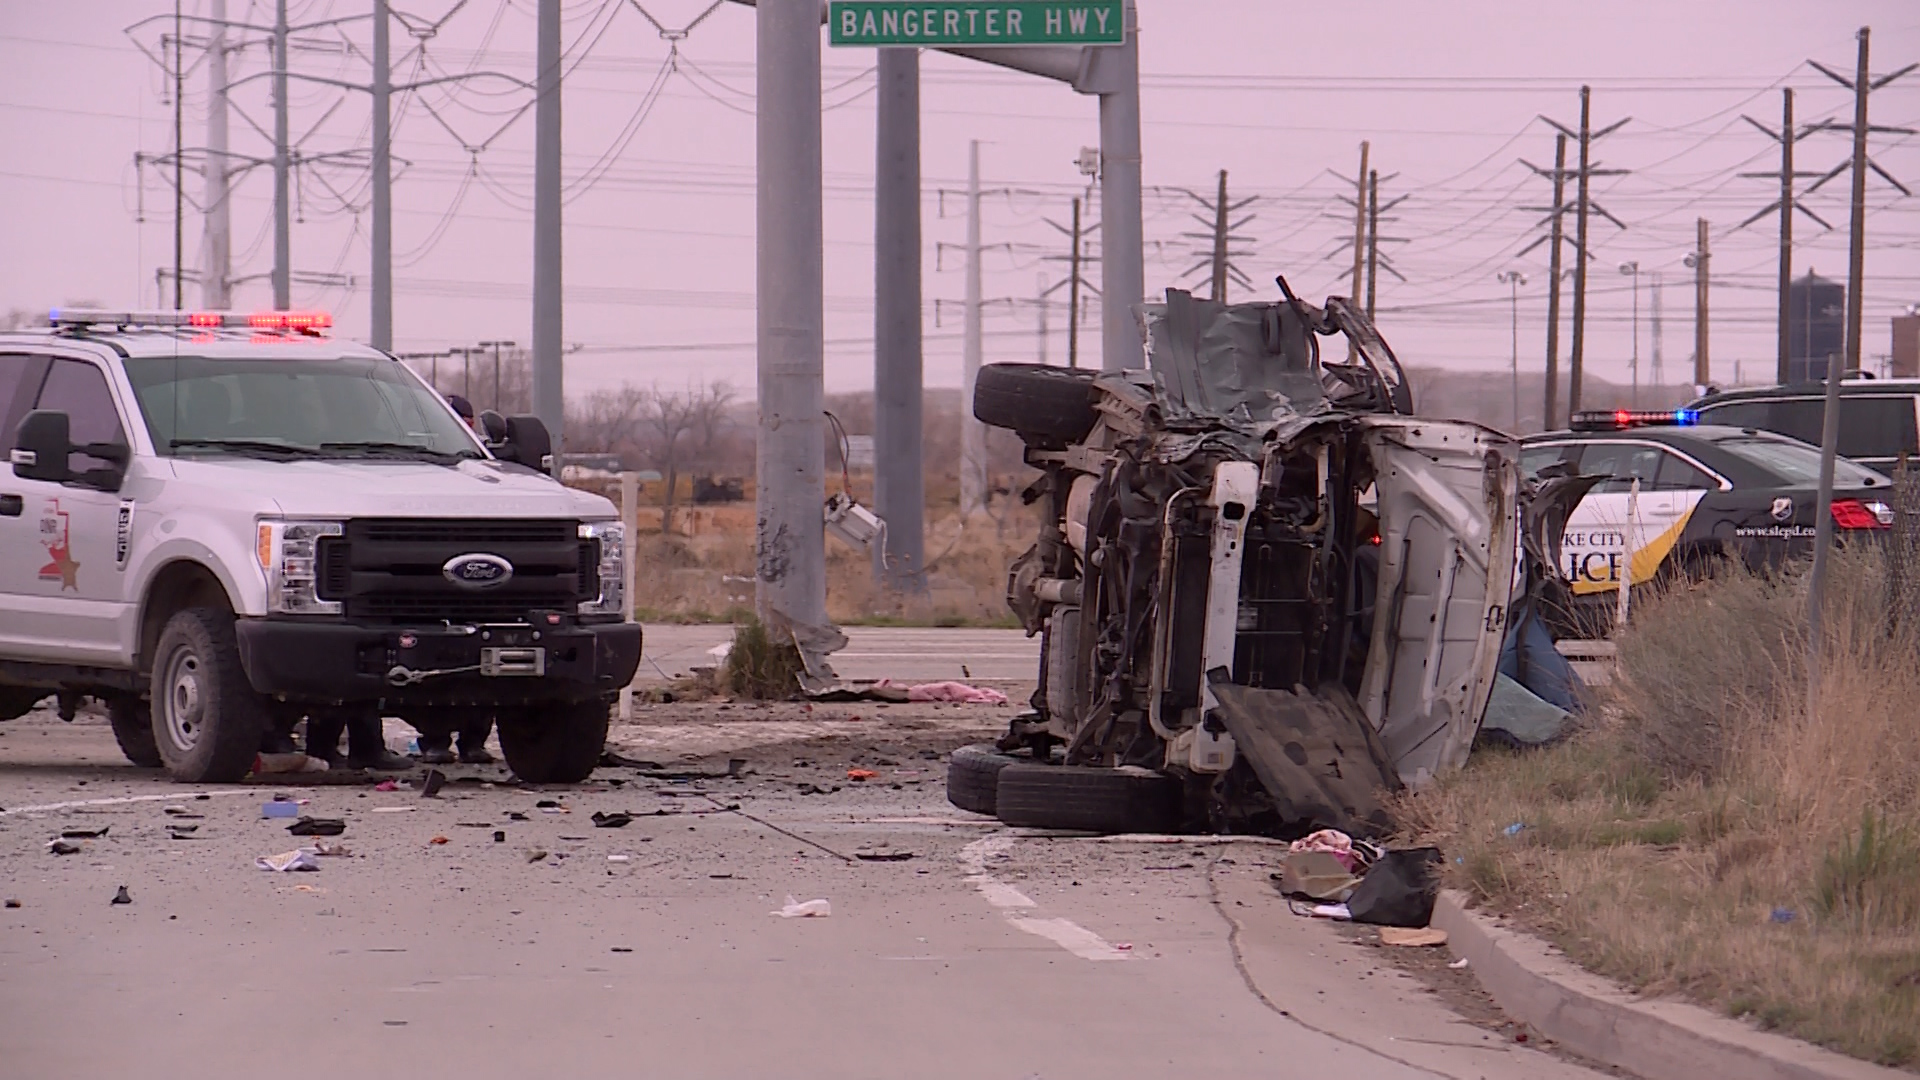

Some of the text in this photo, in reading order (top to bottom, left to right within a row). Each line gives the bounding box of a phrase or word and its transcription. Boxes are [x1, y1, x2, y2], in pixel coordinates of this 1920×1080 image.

[840, 7, 1115, 37] BANGERTER HWY.
[1564, 531, 1625, 547] KE CITY
[1735, 524, 1817, 540] www.slcpd.co
[462, 561, 498, 579] Ford
[1567, 551, 1623, 583] ICE
